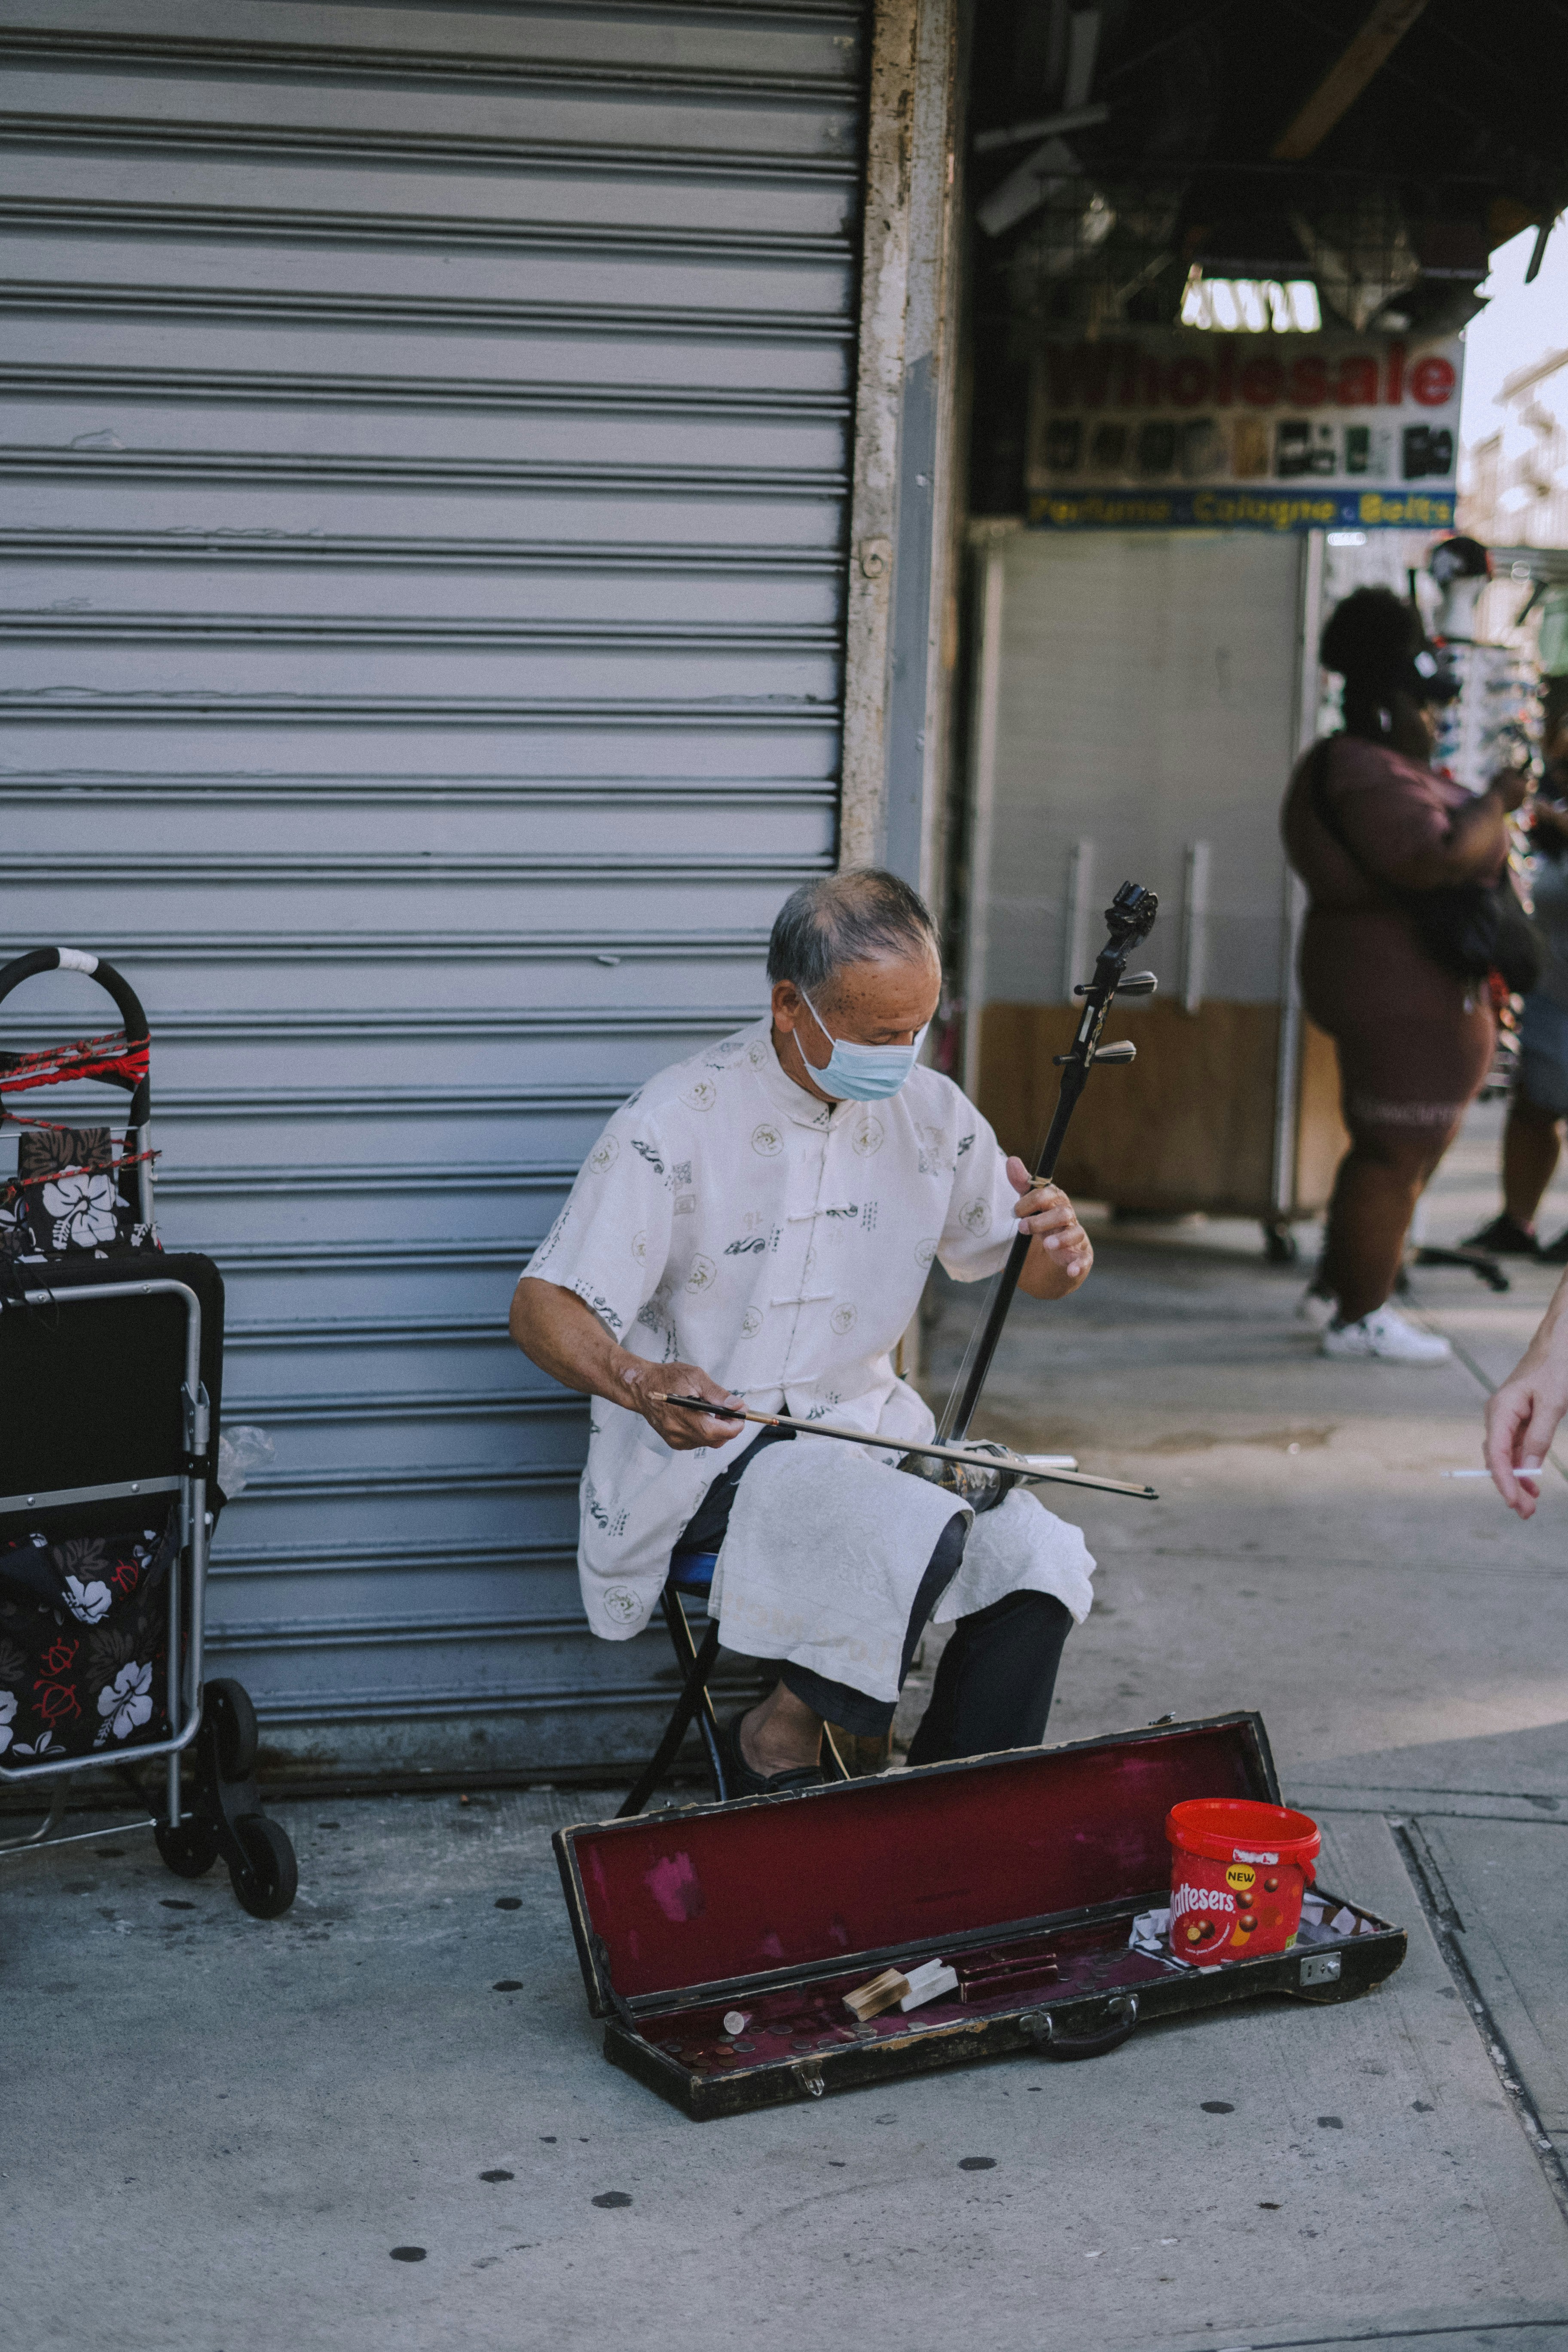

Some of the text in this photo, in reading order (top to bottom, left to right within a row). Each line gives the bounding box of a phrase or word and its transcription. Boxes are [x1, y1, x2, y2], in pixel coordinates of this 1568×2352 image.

[1044, 339, 1455, 407] Wholesale
[1191, 491, 1335, 529] Cologne
[1358, 493, 1452, 523] Belts
[1228, 1872, 1255, 1883] NEW
